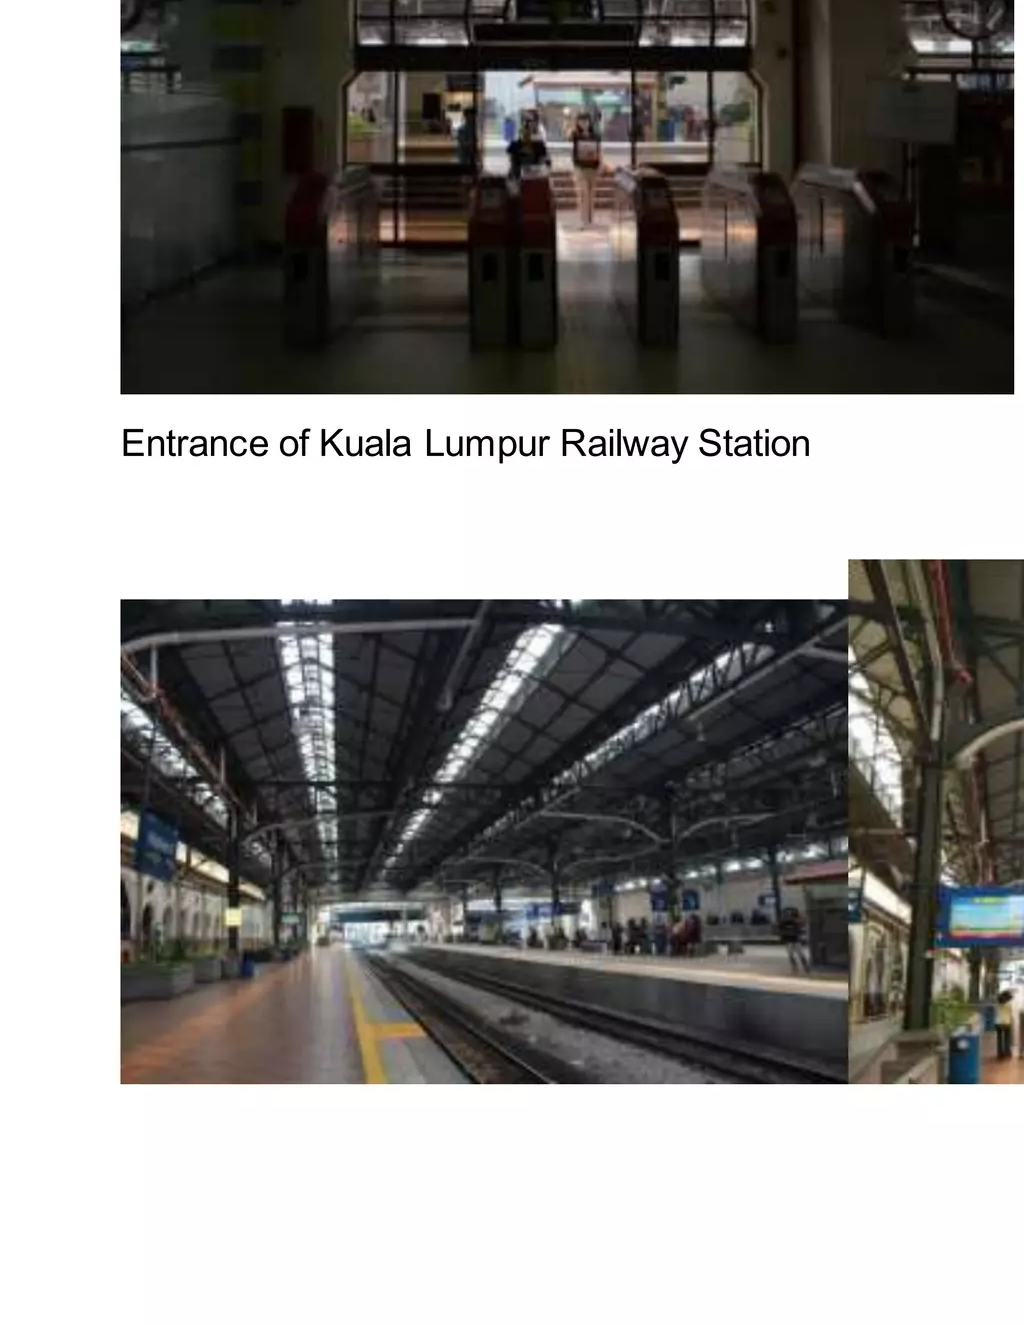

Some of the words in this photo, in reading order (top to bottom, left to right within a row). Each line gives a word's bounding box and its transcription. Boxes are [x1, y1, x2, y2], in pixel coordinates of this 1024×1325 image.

[122, 428, 269, 458] Entrance
[279, 427, 312, 458] of
[320, 428, 412, 458] Kuala
[426, 428, 551, 465] Lumpur
[562, 428, 689, 465] Railway
[698, 427, 810, 458] Station
